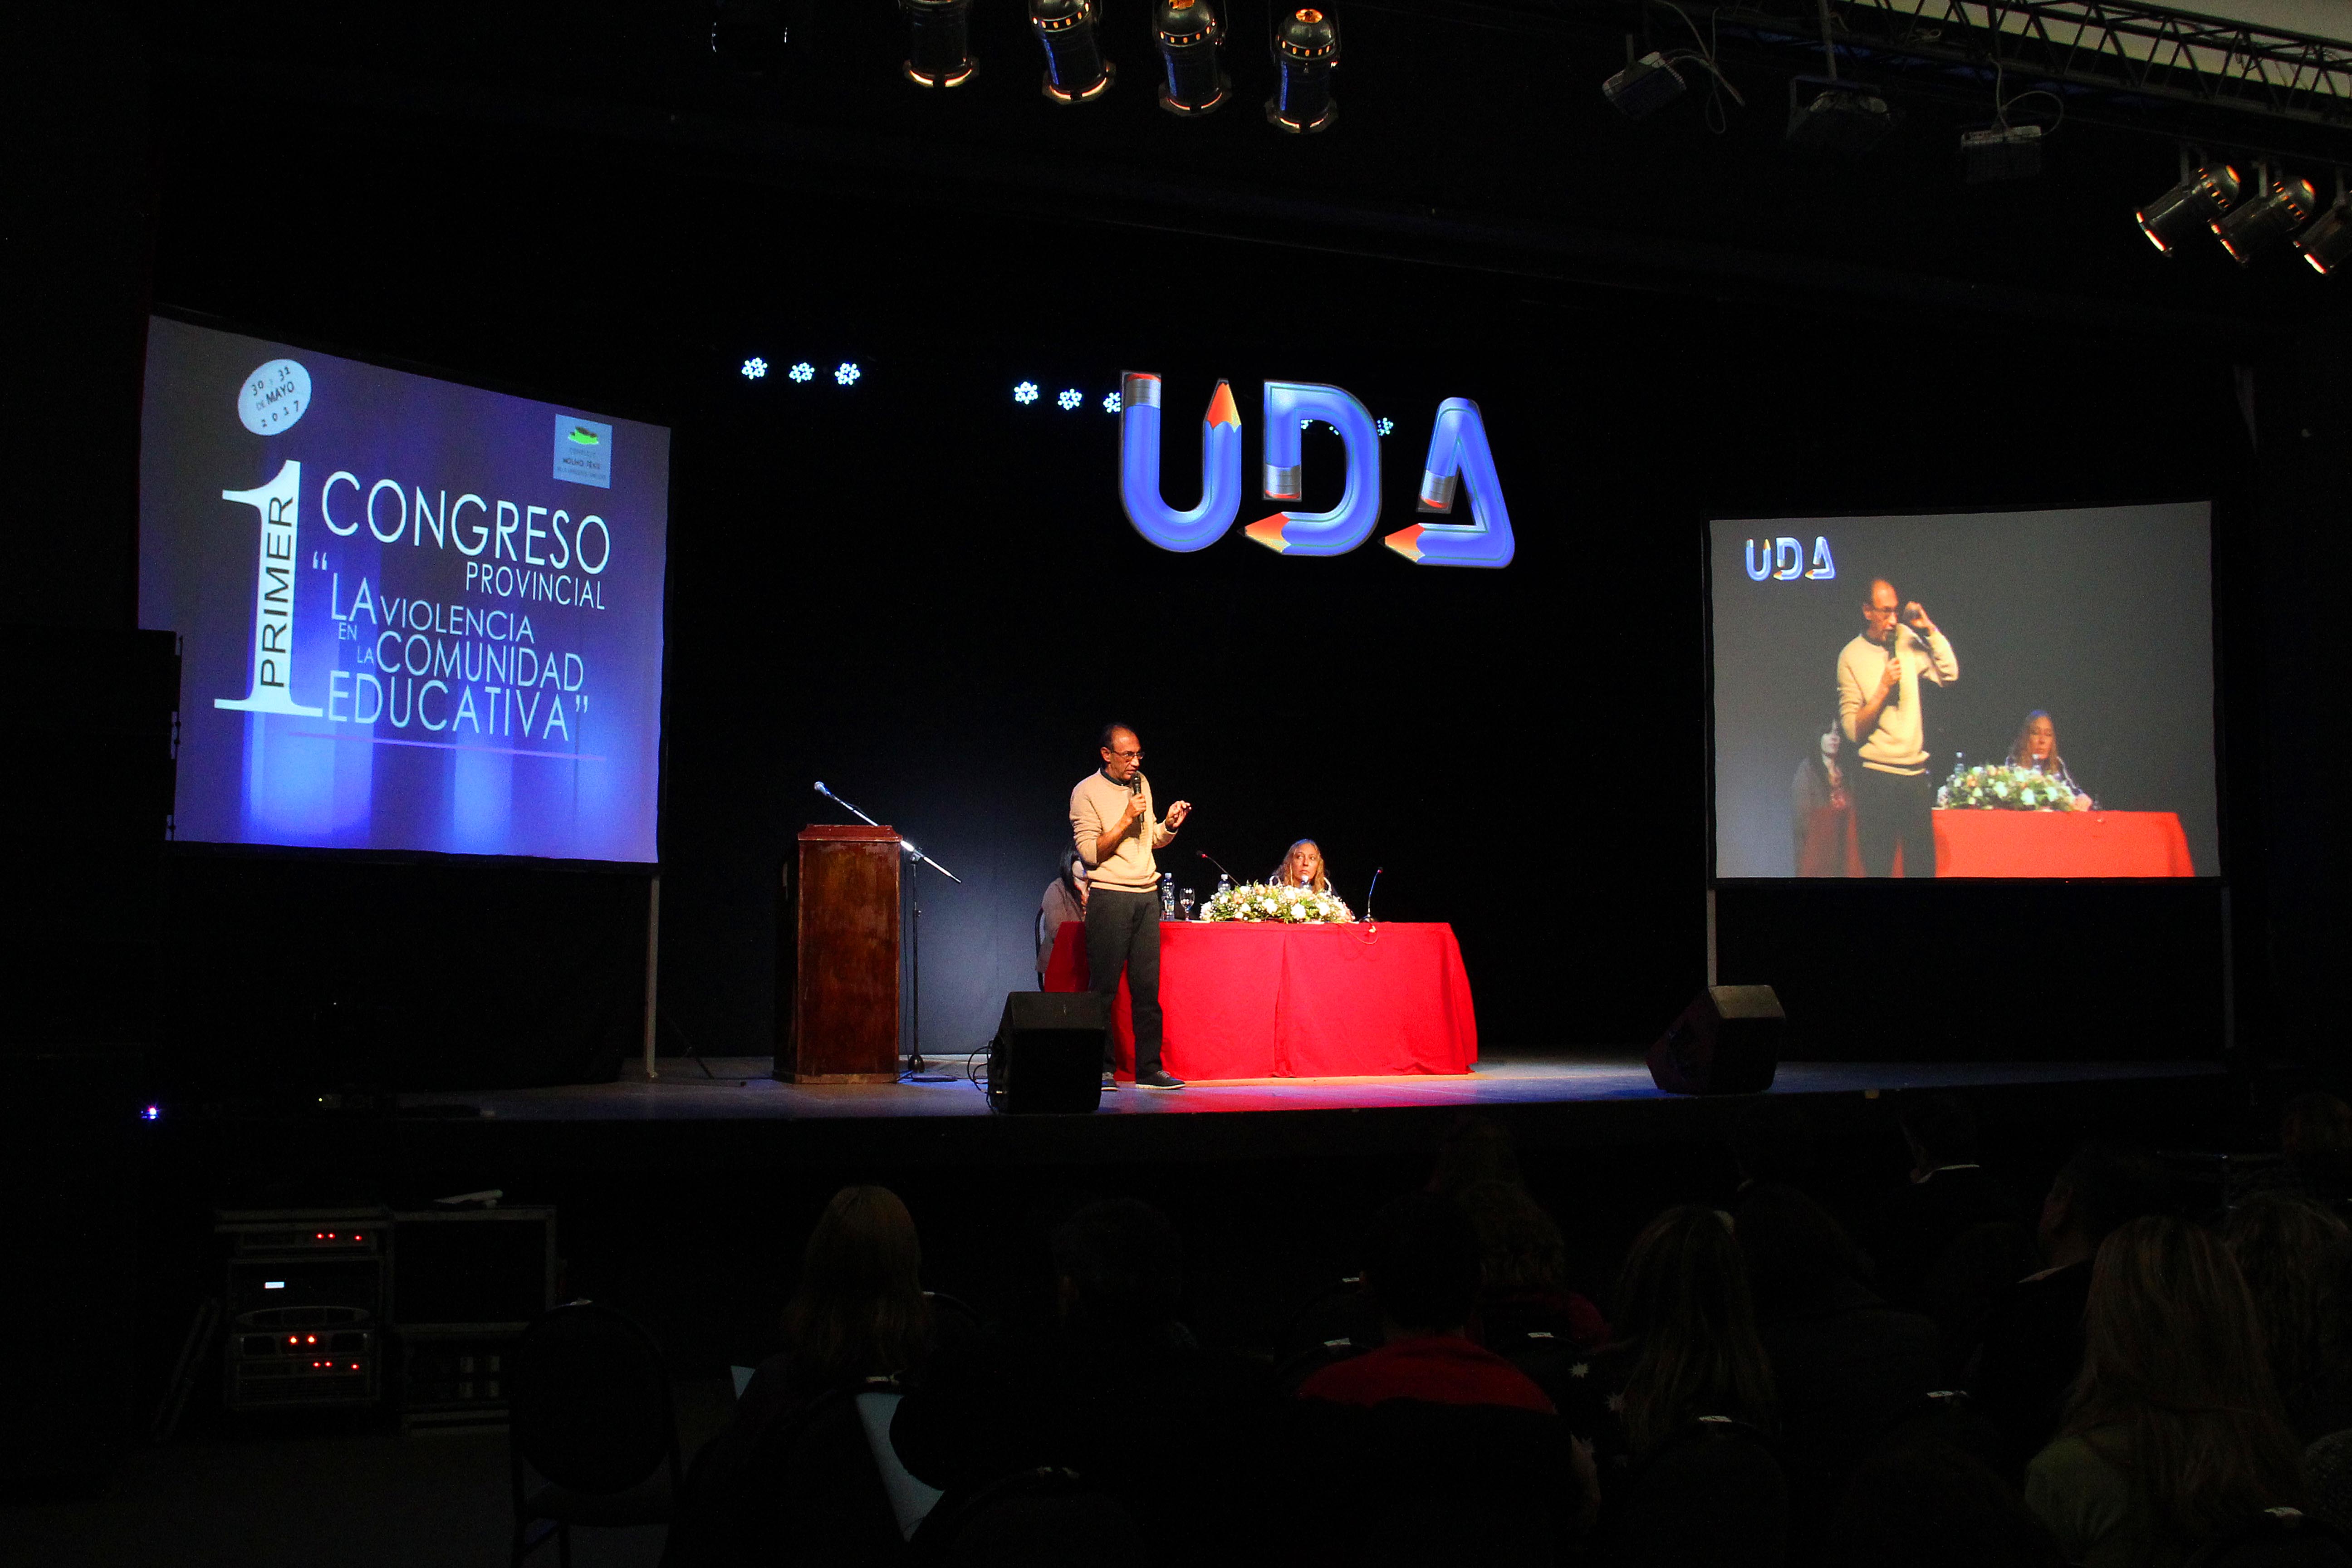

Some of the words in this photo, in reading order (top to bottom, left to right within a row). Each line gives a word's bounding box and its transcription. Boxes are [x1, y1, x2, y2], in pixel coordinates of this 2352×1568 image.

[251, 380, 264, 396] 30
[278, 366, 291, 382] 31
[266, 381, 294, 405] MAYO
[1118, 370, 1515, 569] UDA
[322, 470, 611, 575] CONGRESO
[1745, 536, 1837, 582] UDA
[260, 497, 294, 687] PRIMER
[466, 561, 605, 610] PROVINCIAL
[338, 621, 358, 641] EN
[380, 595, 535, 644] VIOLENCIA
[357, 645, 375, 666] LA
[377, 630, 584, 692] COMUNIDAD
